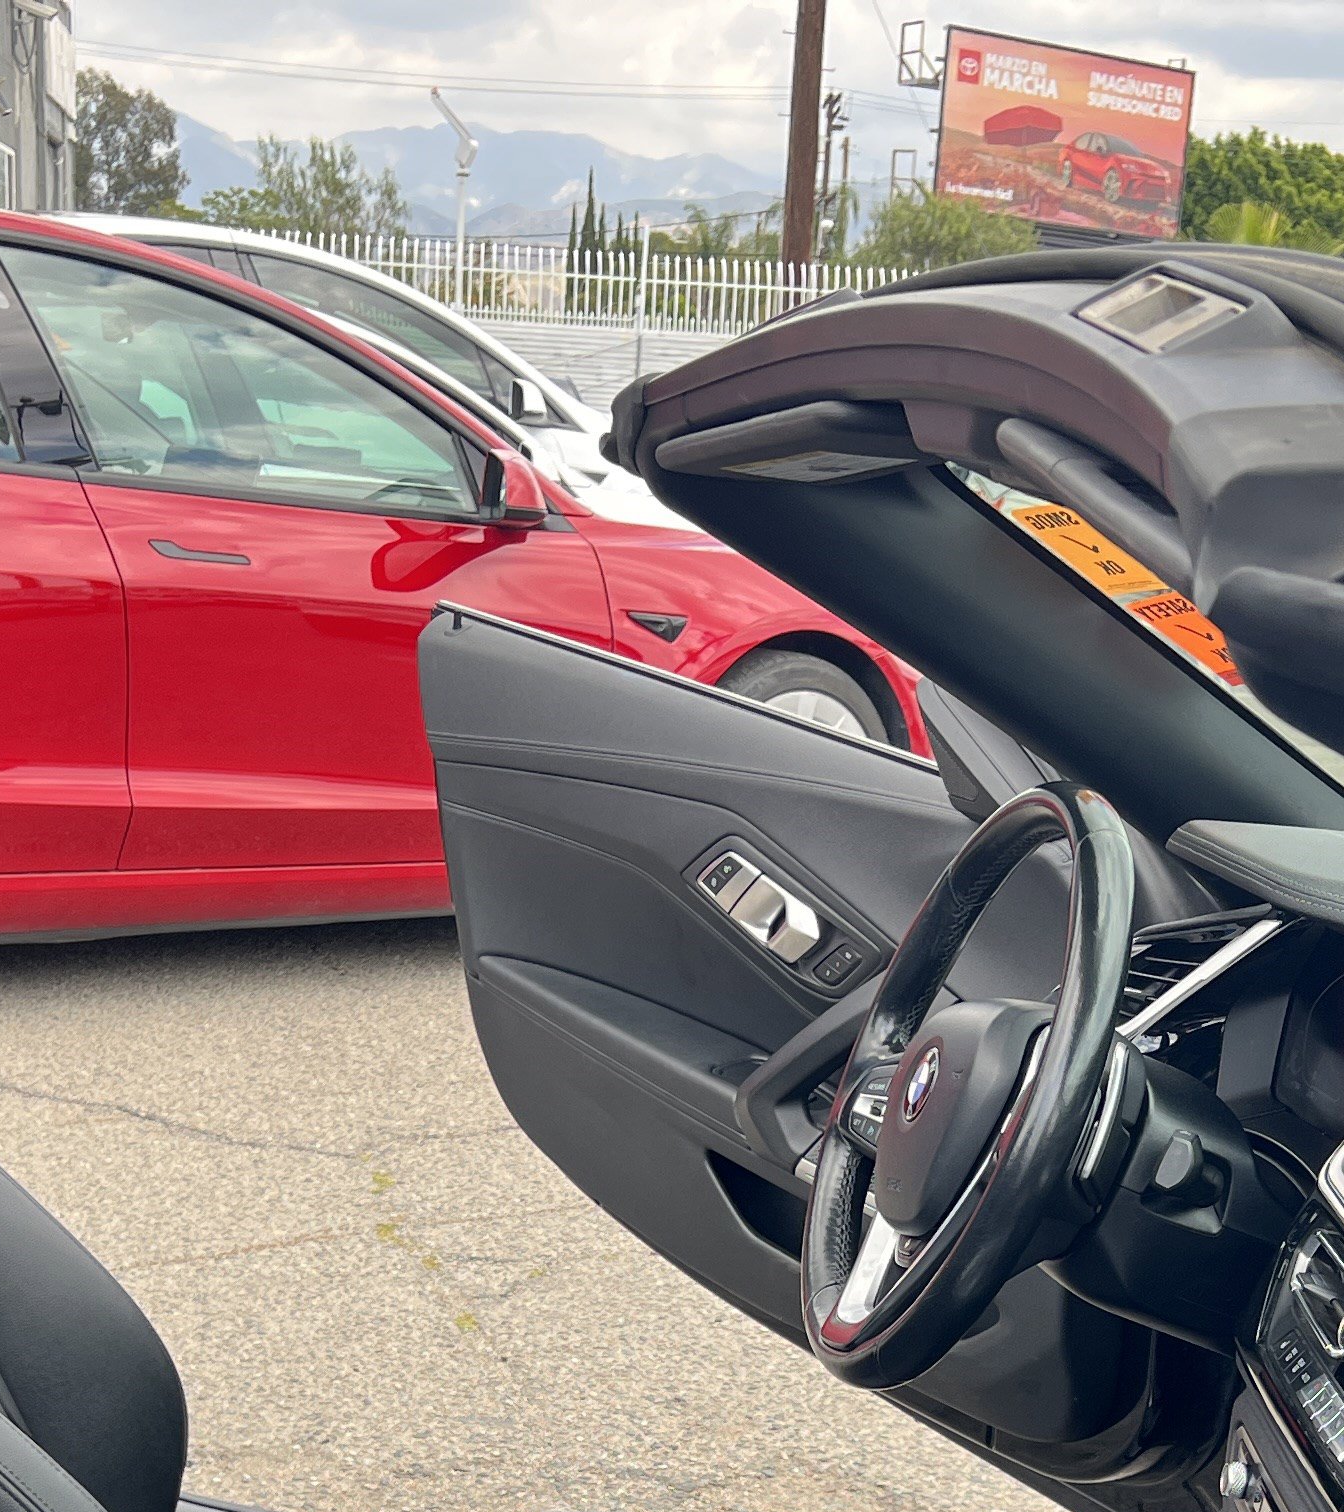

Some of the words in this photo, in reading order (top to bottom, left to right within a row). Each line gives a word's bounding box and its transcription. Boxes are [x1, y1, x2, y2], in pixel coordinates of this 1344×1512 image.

[985, 52, 1029, 73] MARZO
[1031, 61, 1048, 75] EN
[983, 68, 1059, 99] MARCHA
[1089, 71, 1165, 101] IMAGÍNATE
[1165, 85, 1184, 105] EN
[1086, 91, 1159, 118] SUPERSONIC
[1159, 104, 1183, 122] RED
